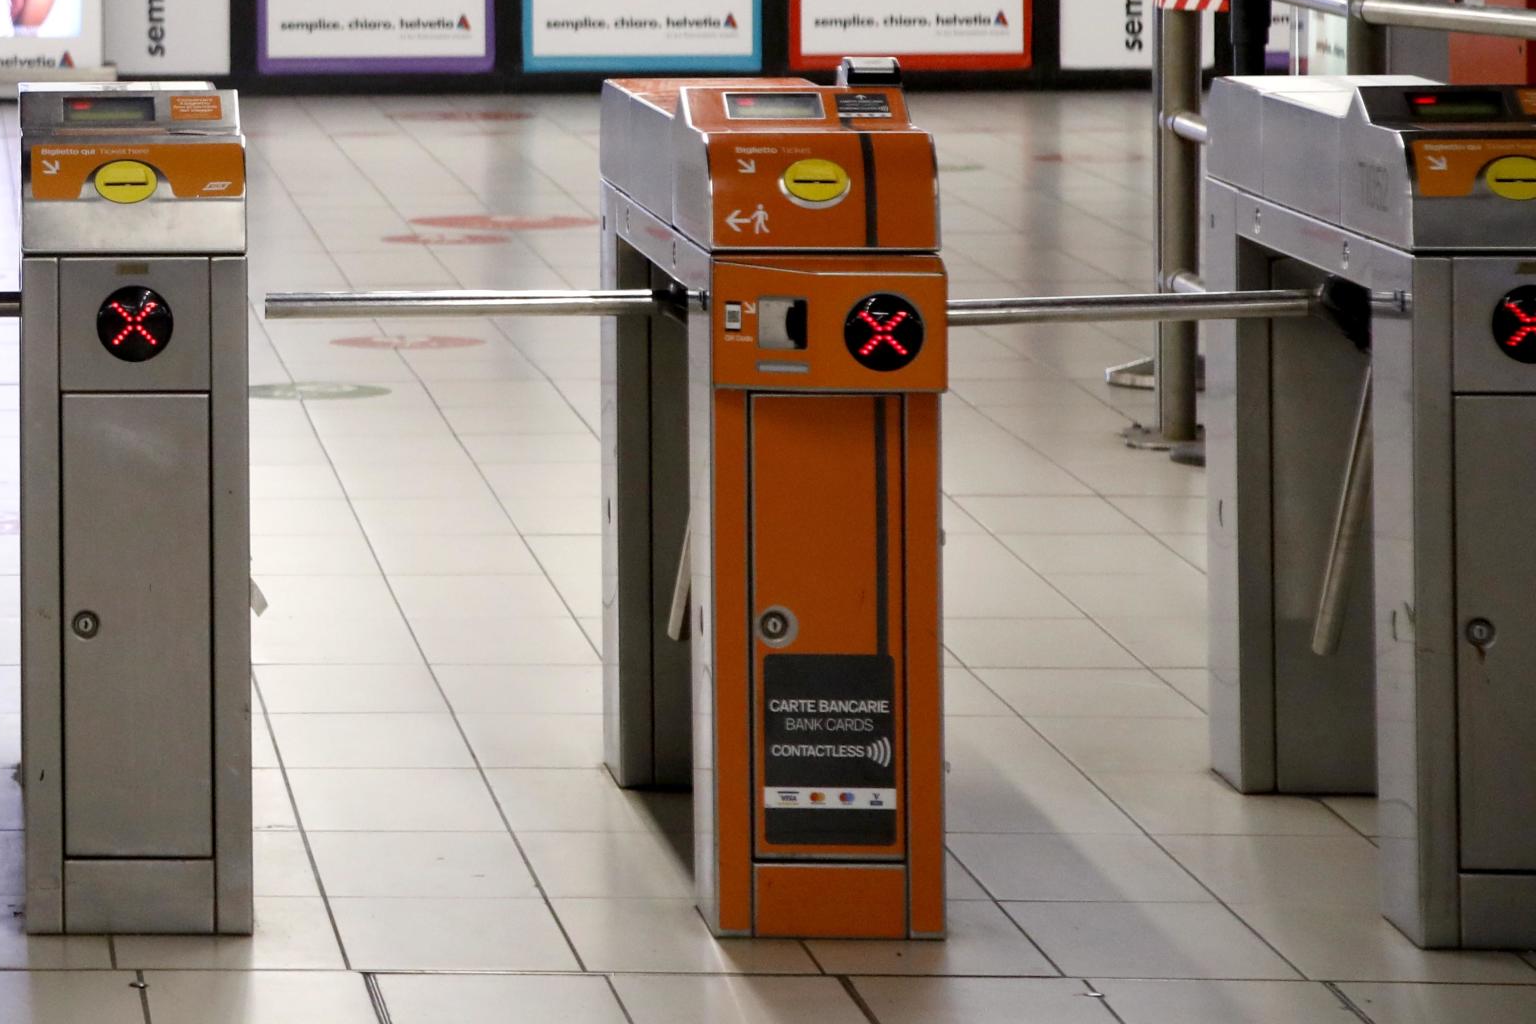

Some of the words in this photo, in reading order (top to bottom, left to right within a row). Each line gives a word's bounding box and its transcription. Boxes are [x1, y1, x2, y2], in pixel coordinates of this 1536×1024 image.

[281, 18, 344, 34] semplice.
[349, 17, 395, 31] chiaro.
[400, 18, 454, 30] helvetia
[546, 16, 609, 33] semplice.
[614, 15, 662, 30] chiaro.
[666, 15, 721, 29] helvetia
[814, 14, 879, 31] semplice.
[883, 12, 932, 25] chiaro.
[936, 12, 991, 25] helvetia
[41, 148, 79, 156] Biglietto
[770, 700, 816, 712] CARTE
[819, 701, 889, 713] BANCARIE
[786, 719, 823, 731] BANK
[827, 719, 873, 731] CARDS
[772, 745, 864, 757] CONTACTLESS
